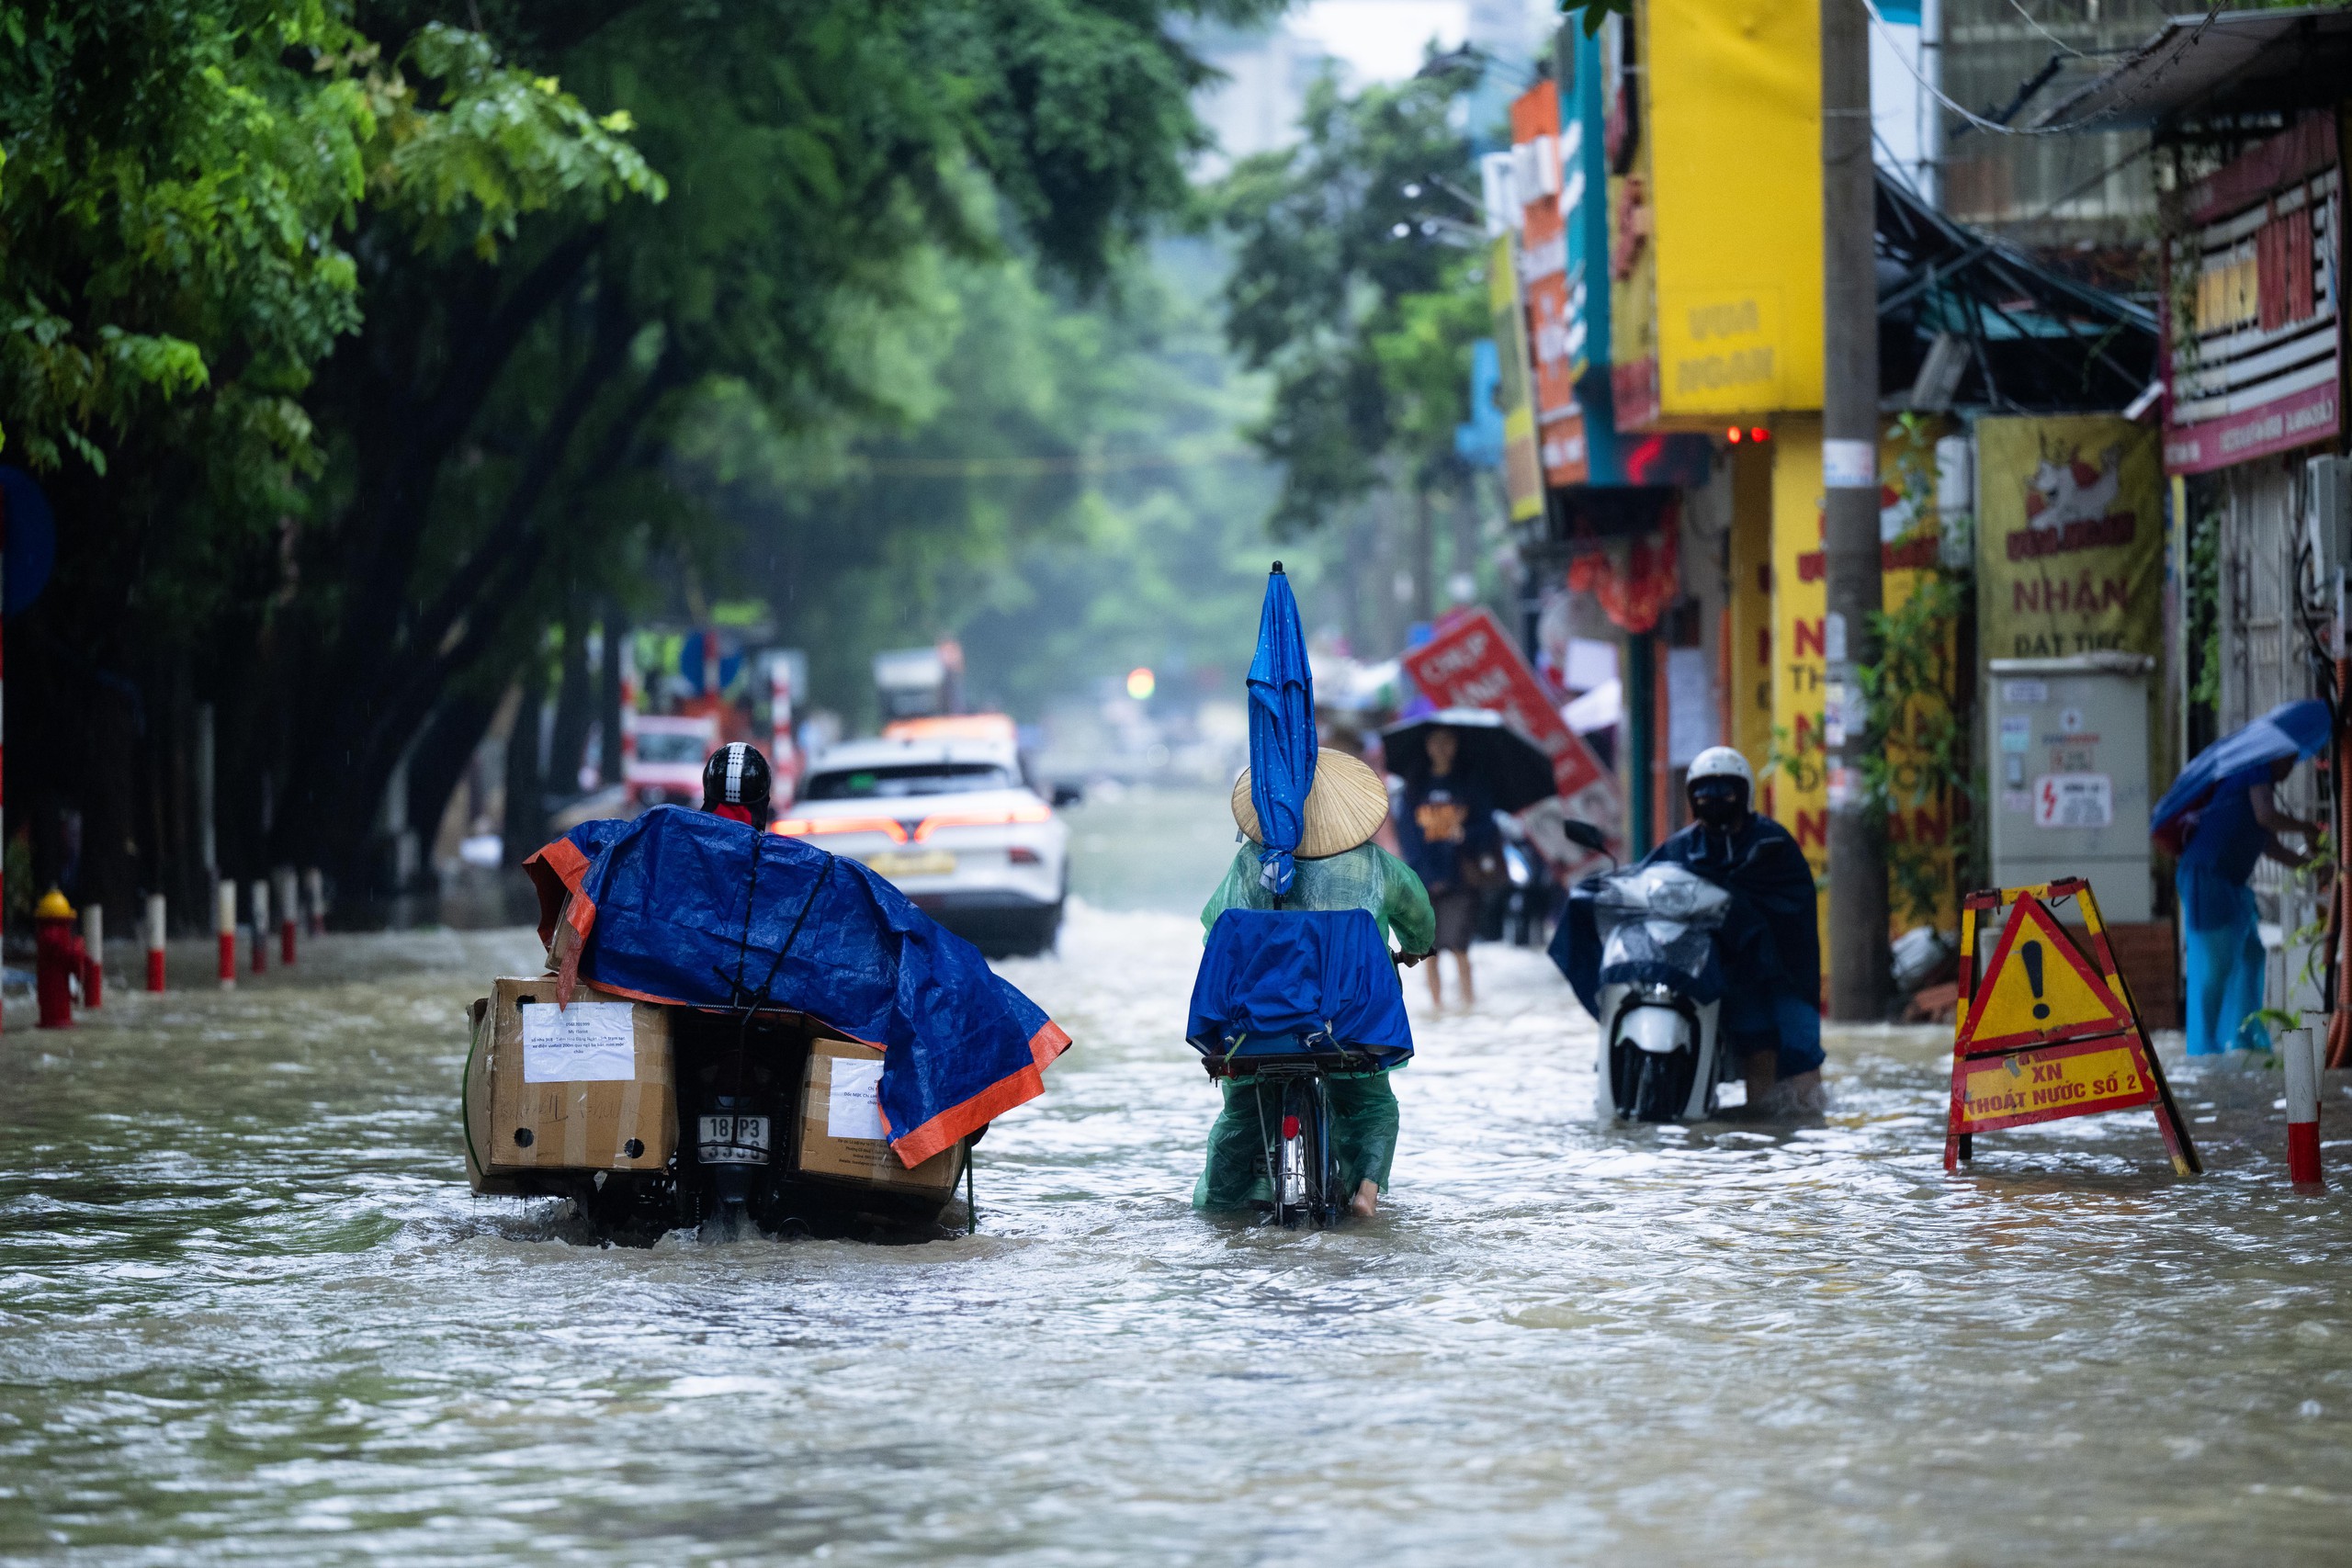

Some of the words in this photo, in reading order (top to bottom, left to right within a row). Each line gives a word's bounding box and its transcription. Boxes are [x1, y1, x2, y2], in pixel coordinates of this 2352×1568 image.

[2031, 1062, 2063, 1084] XN
[1967, 1088, 2027, 1116] THOÁT
[2032, 1079, 2086, 1105] NƯỚC
[2093, 1070, 2119, 1095] SỐ
[2127, 1074, 2137, 1090] 2
[739, 1118, 760, 1138] P3
